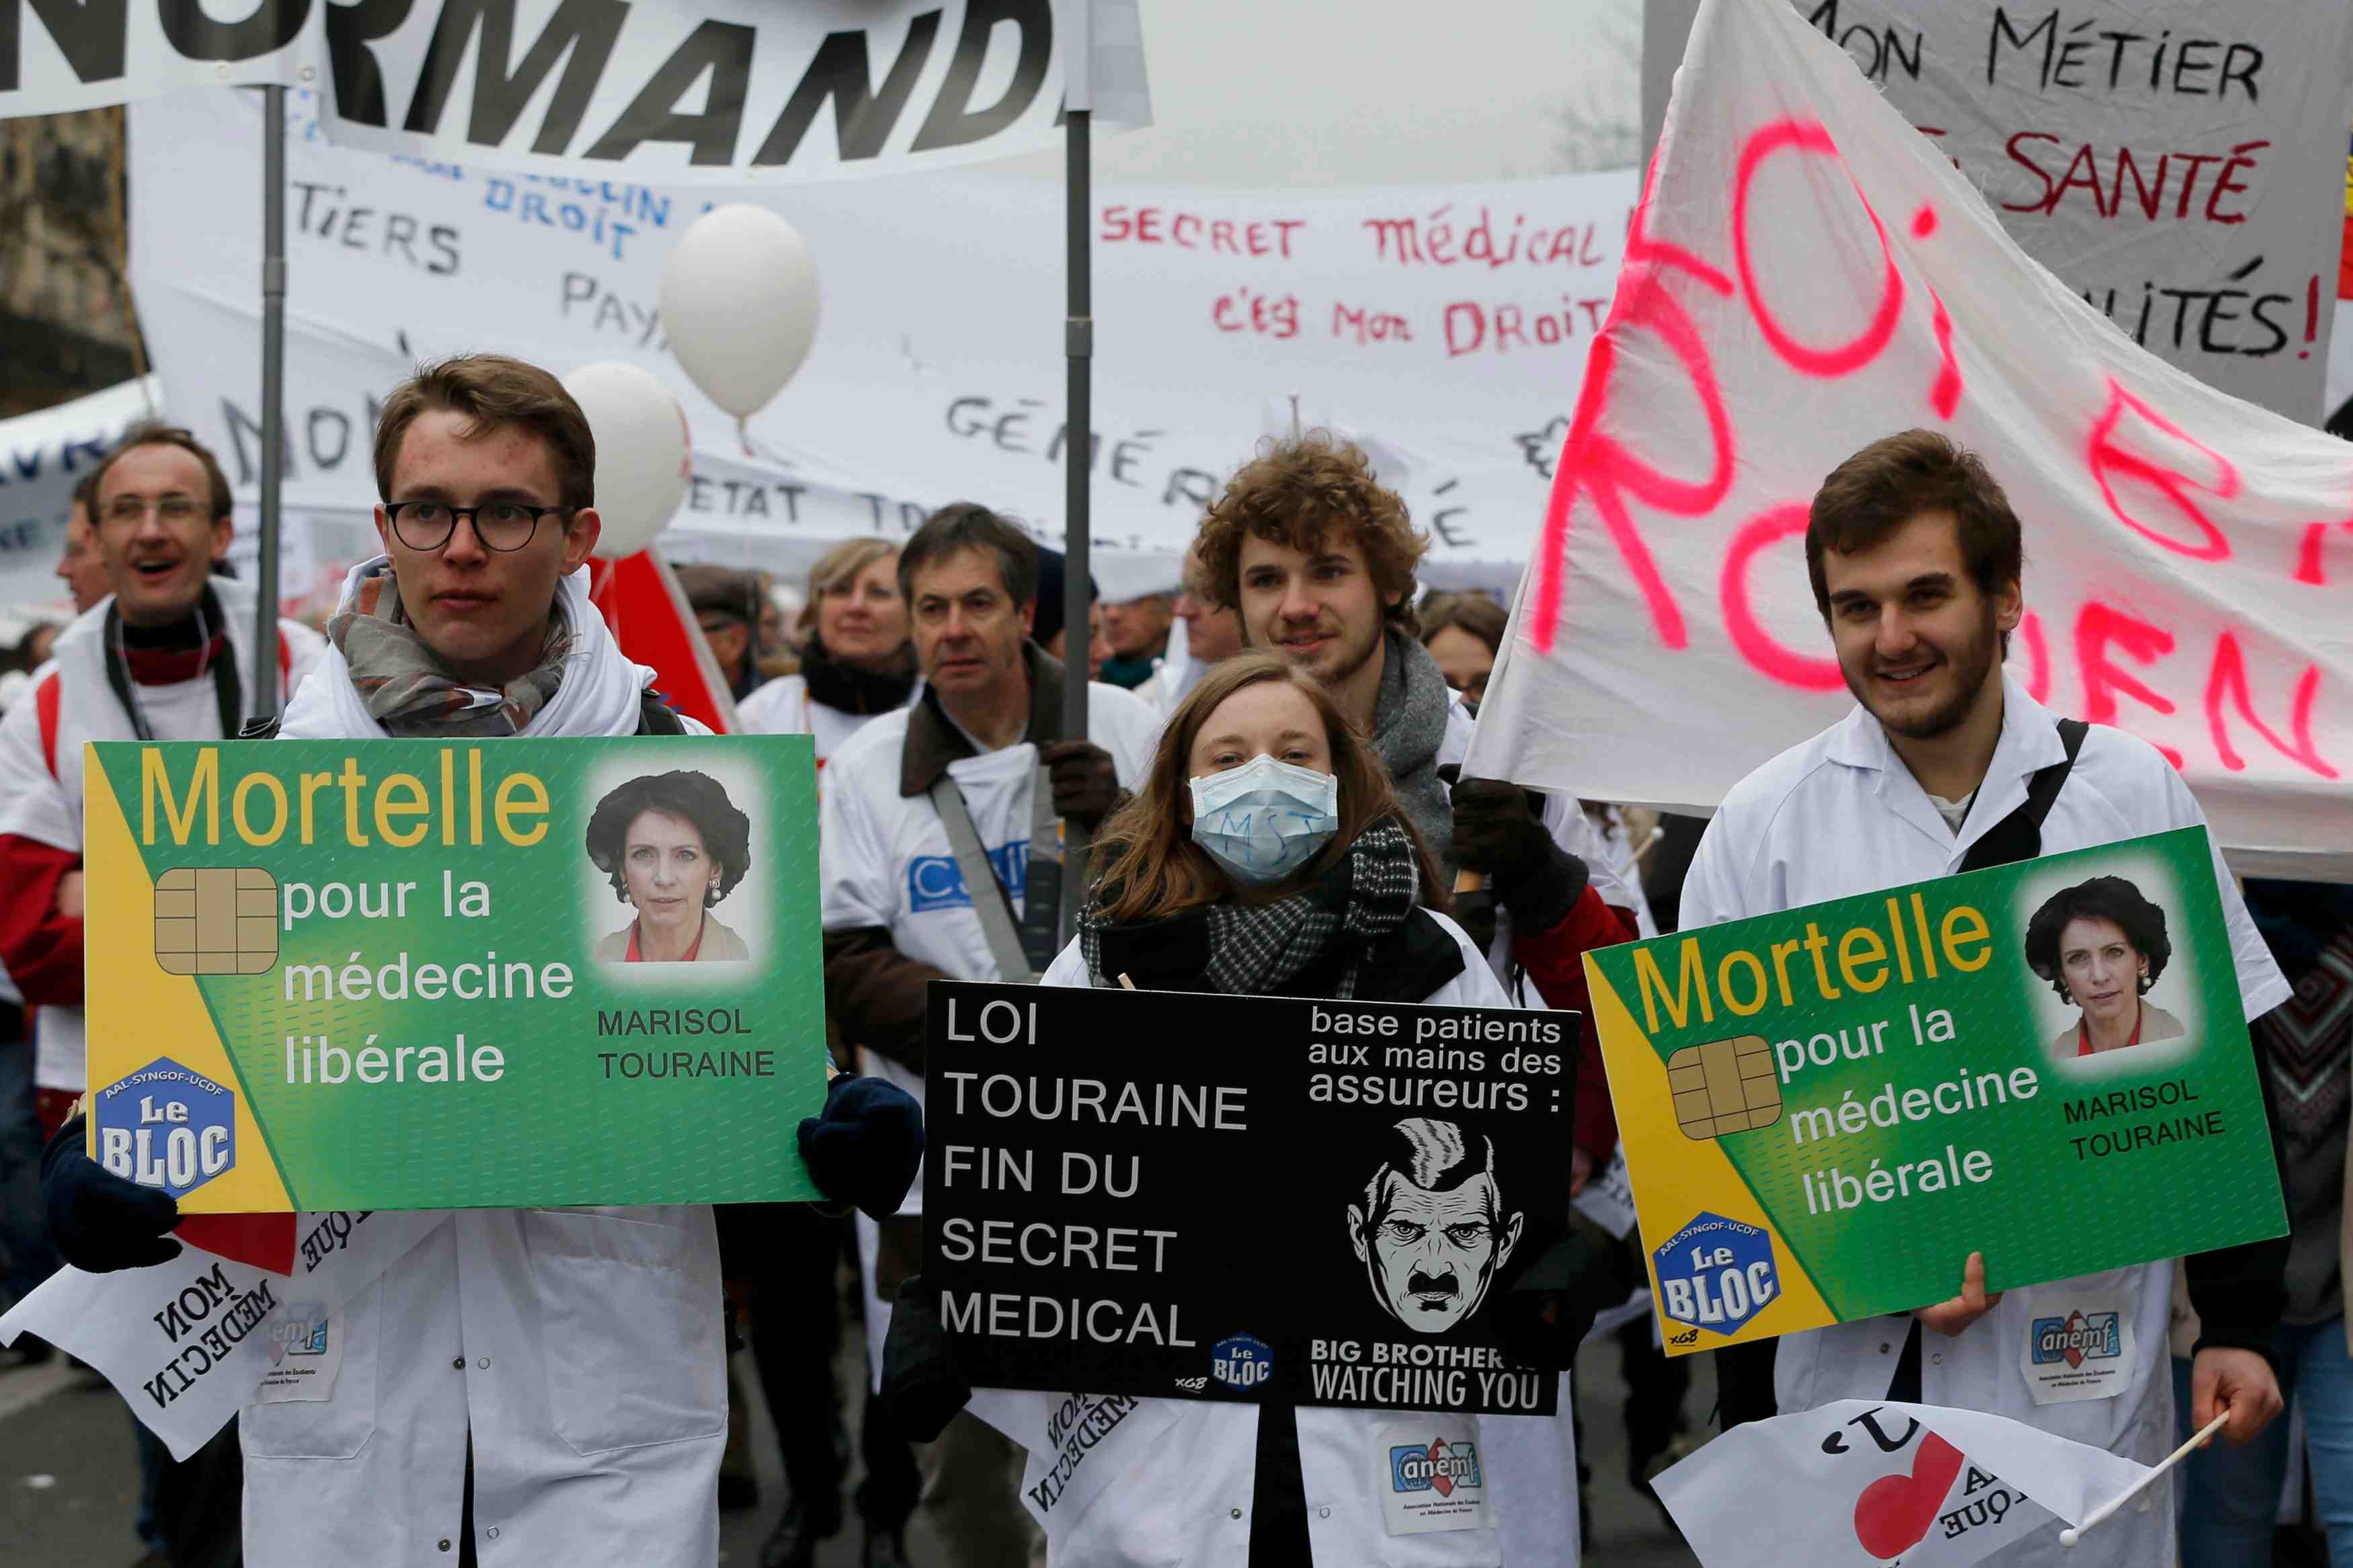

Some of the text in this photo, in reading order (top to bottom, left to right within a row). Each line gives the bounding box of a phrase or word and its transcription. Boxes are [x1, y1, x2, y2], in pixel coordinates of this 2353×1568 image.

[2001, 131, 2272, 223] SANTÉ
[1101, 204, 1306, 259] SECRET
[141, 747, 550, 848] Mortelle
[284, 870, 490, 930] pour la
[285, 951, 574, 1001] médecine
[1633, 892, 1992, 1034] Mortelle
[598, 1008, 752, 1037] MARISOL
[947, 998, 1037, 1045] LOI
[1311, 1005, 1561, 1044] base patients
[1774, 1003, 1956, 1083] pour la
[285, 1034, 505, 1084] libérale
[598, 1050, 775, 1079] TOURAINE
[1308, 1042, 1562, 1075] aux mains des
[140, 1096, 189, 1124] Le
[944, 1072, 1248, 1130] TOURAINE
[1308, 1073, 1529, 1112] assureurs
[1790, 1065, 2039, 1145] médecine
[2063, 1079, 2198, 1124] MARISOL
[102, 1125, 229, 1189] BLOC
[2070, 1111, 2225, 1161] TOURAINE
[944, 1145, 1140, 1198] FIN DU
[1803, 1141, 1994, 1214] libérale
[941, 1218, 1178, 1274] SECRET
[1690, 1246, 1734, 1272] Le
[1664, 1261, 1775, 1323] BLOC
[941, 1290, 1196, 1348] MEDICAL
[2042, 1320, 2113, 1354] anemf
[1213, 1358, 1270, 1385] BLOC
[1231, 1346, 1253, 1359] Le
[1311, 1339, 1505, 1369] BIG BROTHER
[1312, 1364, 1540, 1409] WATCHING YOU
[1404, 1451, 1475, 1483] anemf
